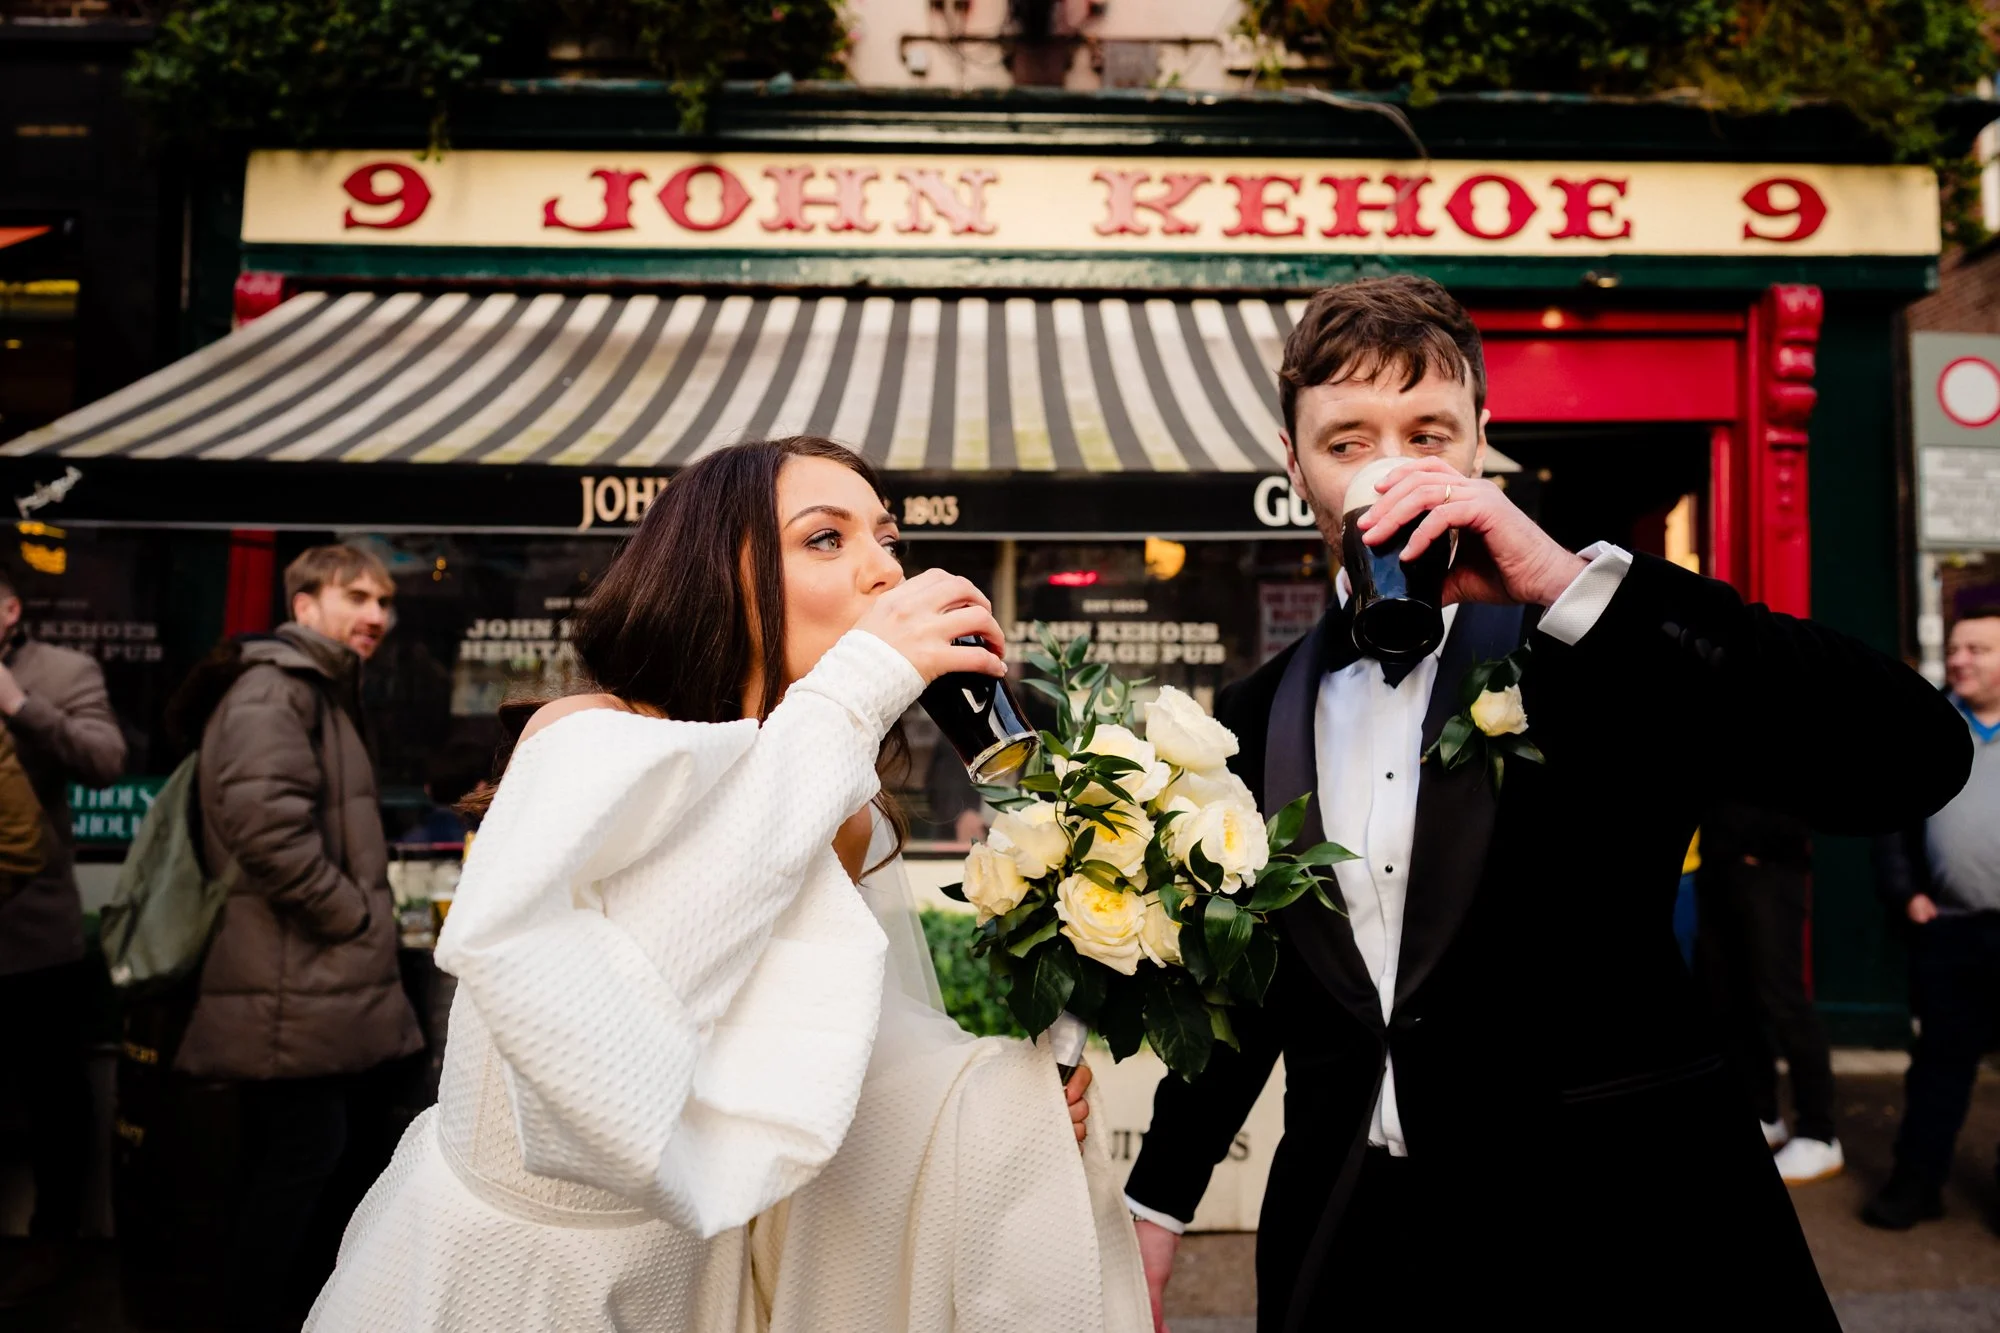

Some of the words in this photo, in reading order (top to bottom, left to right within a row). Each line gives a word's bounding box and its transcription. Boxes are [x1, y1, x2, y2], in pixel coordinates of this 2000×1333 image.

[343, 161, 432, 229] 9
[542, 163, 997, 234] JOHN
[1091, 169, 1633, 241] KEHOE
[1741, 176, 1828, 243] 9
[577, 476, 669, 532] JOH
[903, 496, 959, 525] 1803
[466, 619, 553, 638] JOHN
[1097, 621, 1219, 643] KEHOES
[460, 641, 577, 661] HERITA
[1160, 644, 1226, 664] PUB
